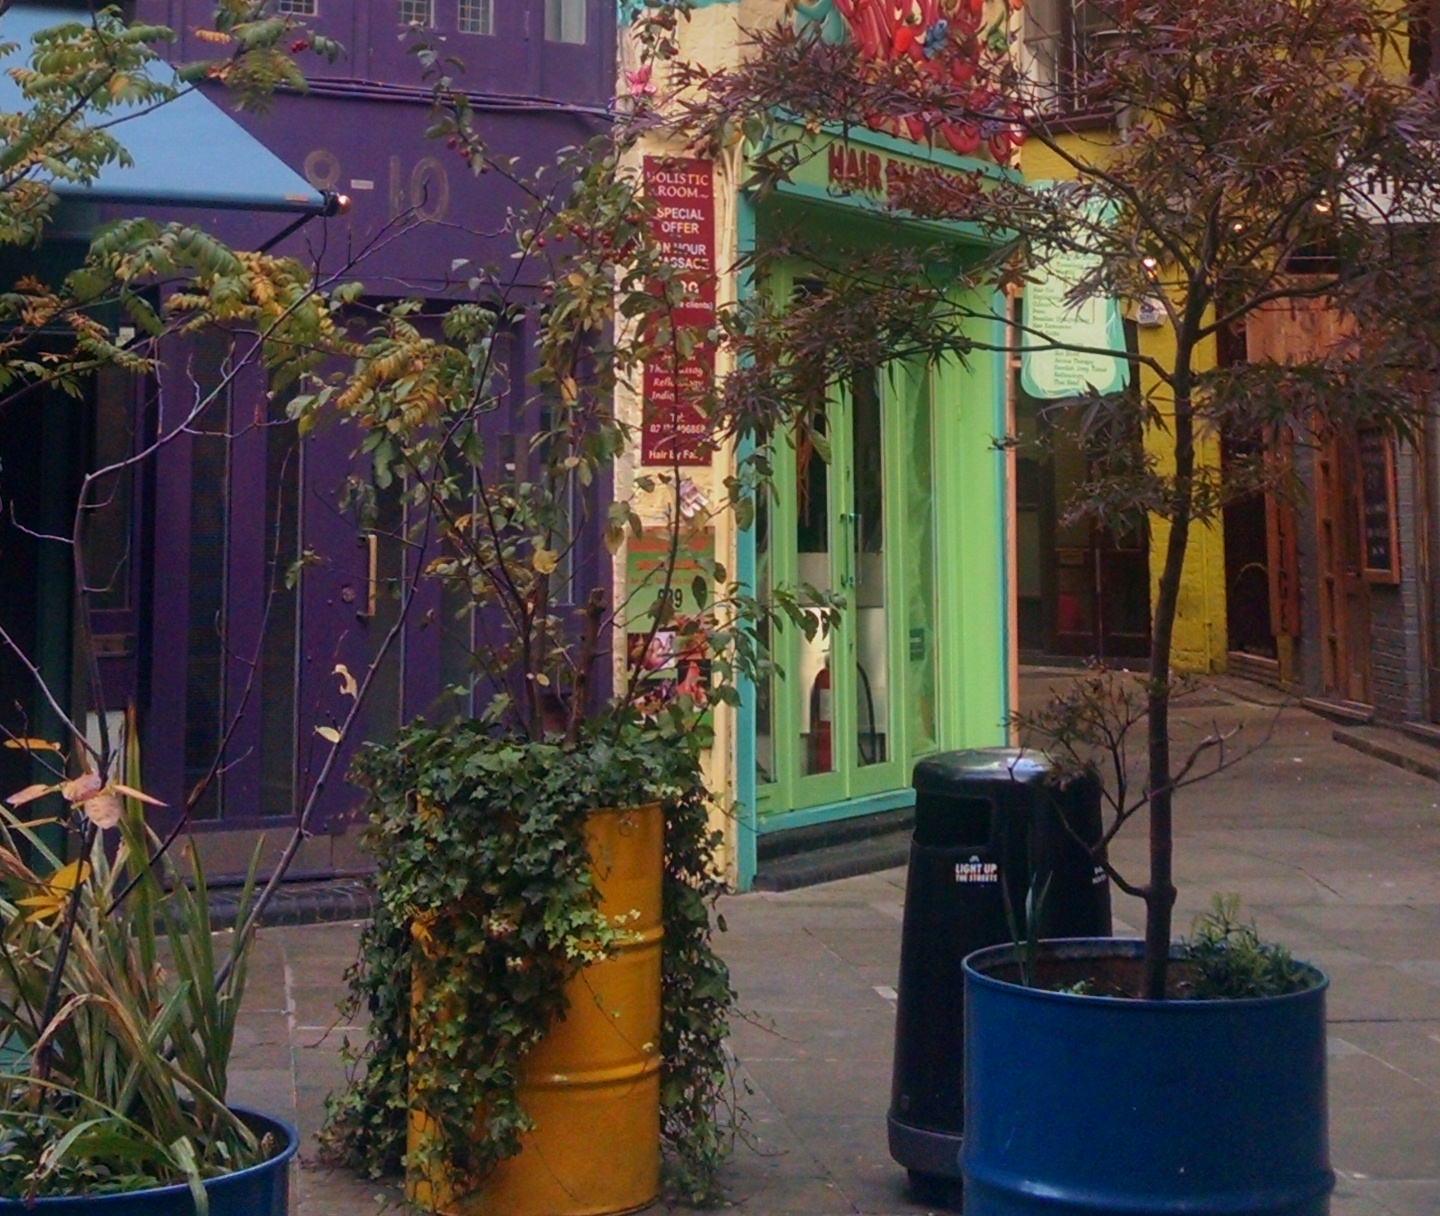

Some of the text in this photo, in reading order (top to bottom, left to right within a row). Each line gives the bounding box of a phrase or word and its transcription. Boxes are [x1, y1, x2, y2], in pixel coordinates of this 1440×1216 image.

[827, 143, 883, 193] HAIR
[656, 207, 705, 221] SPECIAL
[661, 222, 700, 234] OFFER
[648, 450, 667, 460] Hair
[955, 862, 998, 875] LIGHT UP
[955, 874, 998, 883] THE STREETS
